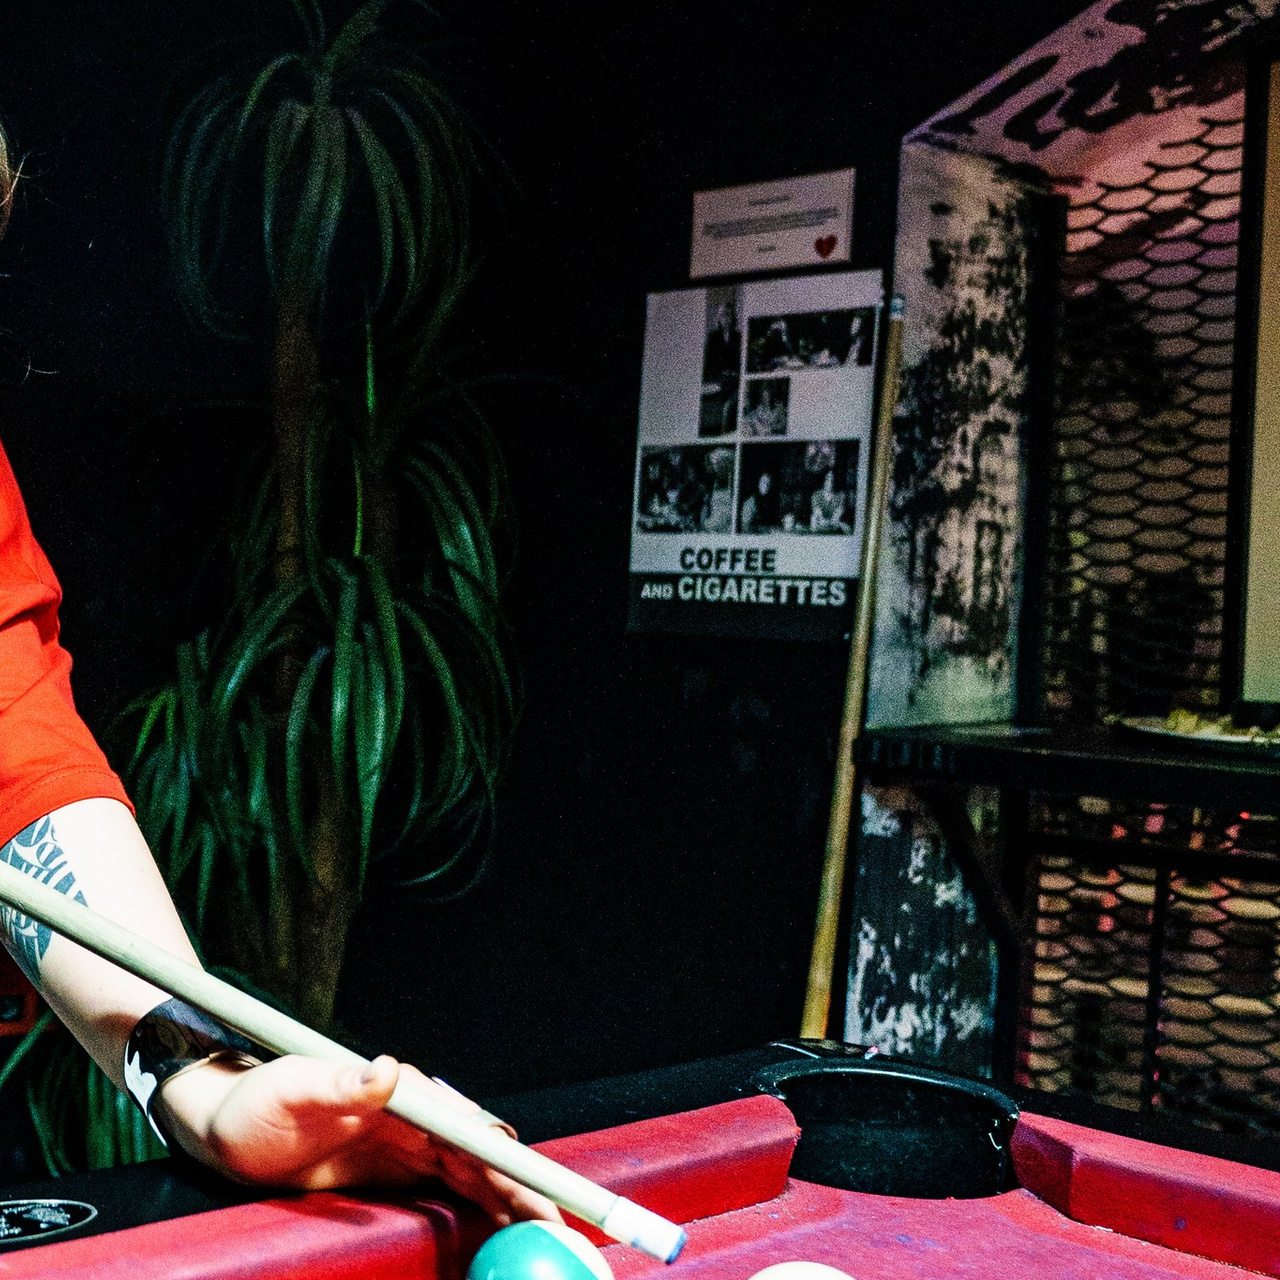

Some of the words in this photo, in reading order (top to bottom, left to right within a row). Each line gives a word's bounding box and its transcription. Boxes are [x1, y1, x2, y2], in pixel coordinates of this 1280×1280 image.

[679, 547, 776, 572] COFFEE
[640, 582, 673, 600] AND
[677, 576, 847, 607] CIGARETTES
